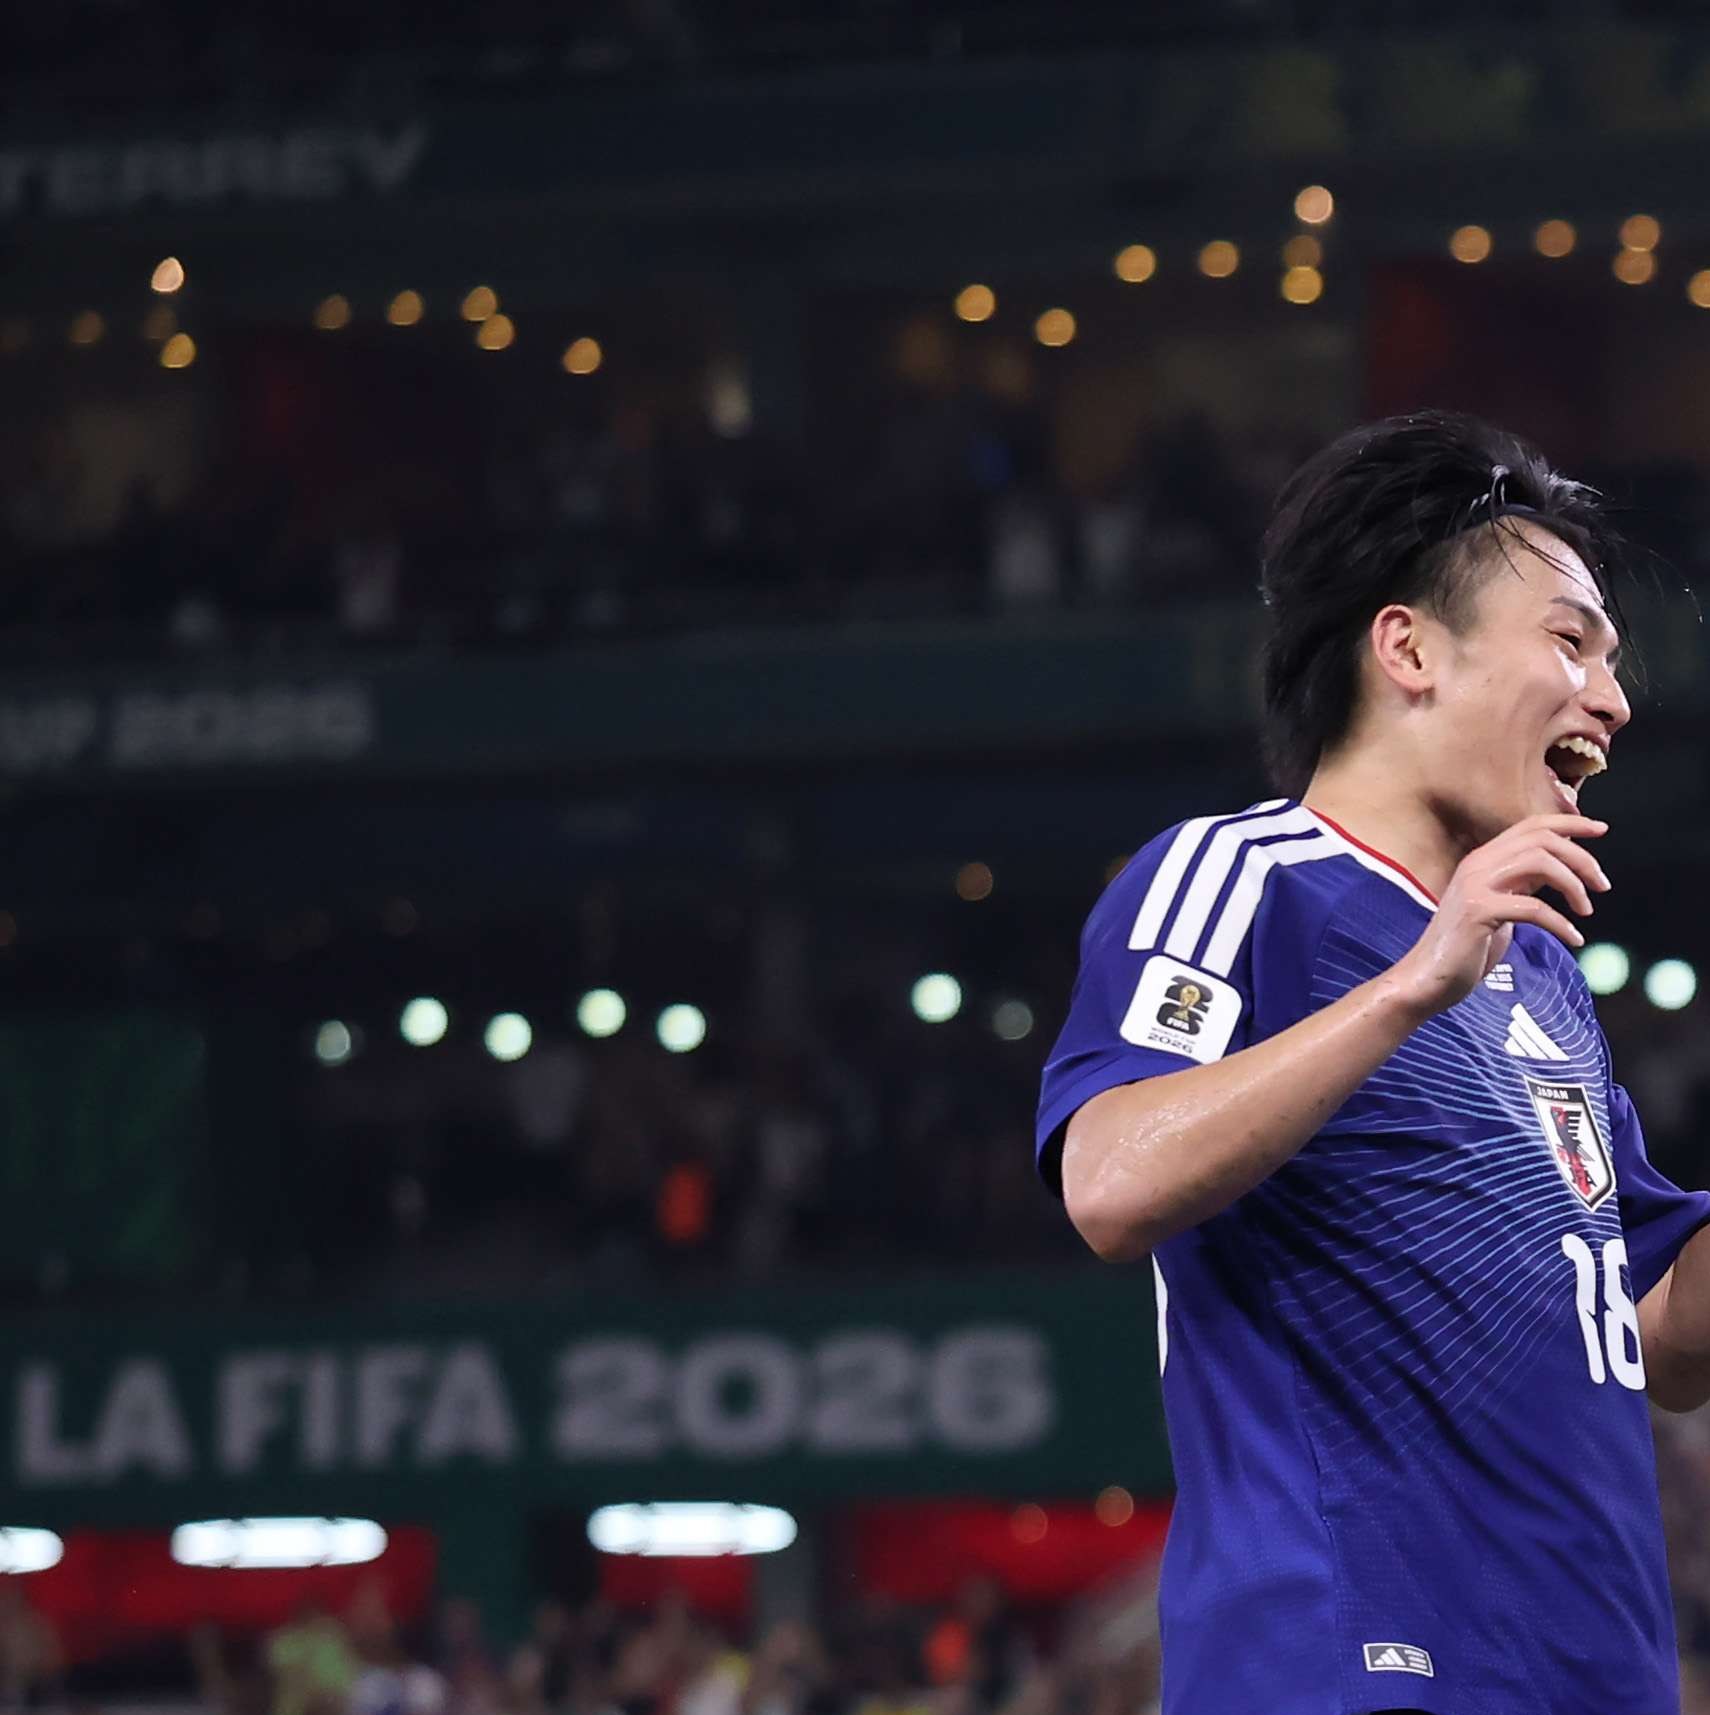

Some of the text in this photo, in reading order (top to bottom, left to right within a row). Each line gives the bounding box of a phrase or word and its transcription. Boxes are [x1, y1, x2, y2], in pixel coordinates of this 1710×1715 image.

[1536, 1086, 1569, 1100] JAPAN
[1561, 1233, 1647, 1390] 18
[14, 1324, 1053, 1484] LA FIFA 2026
